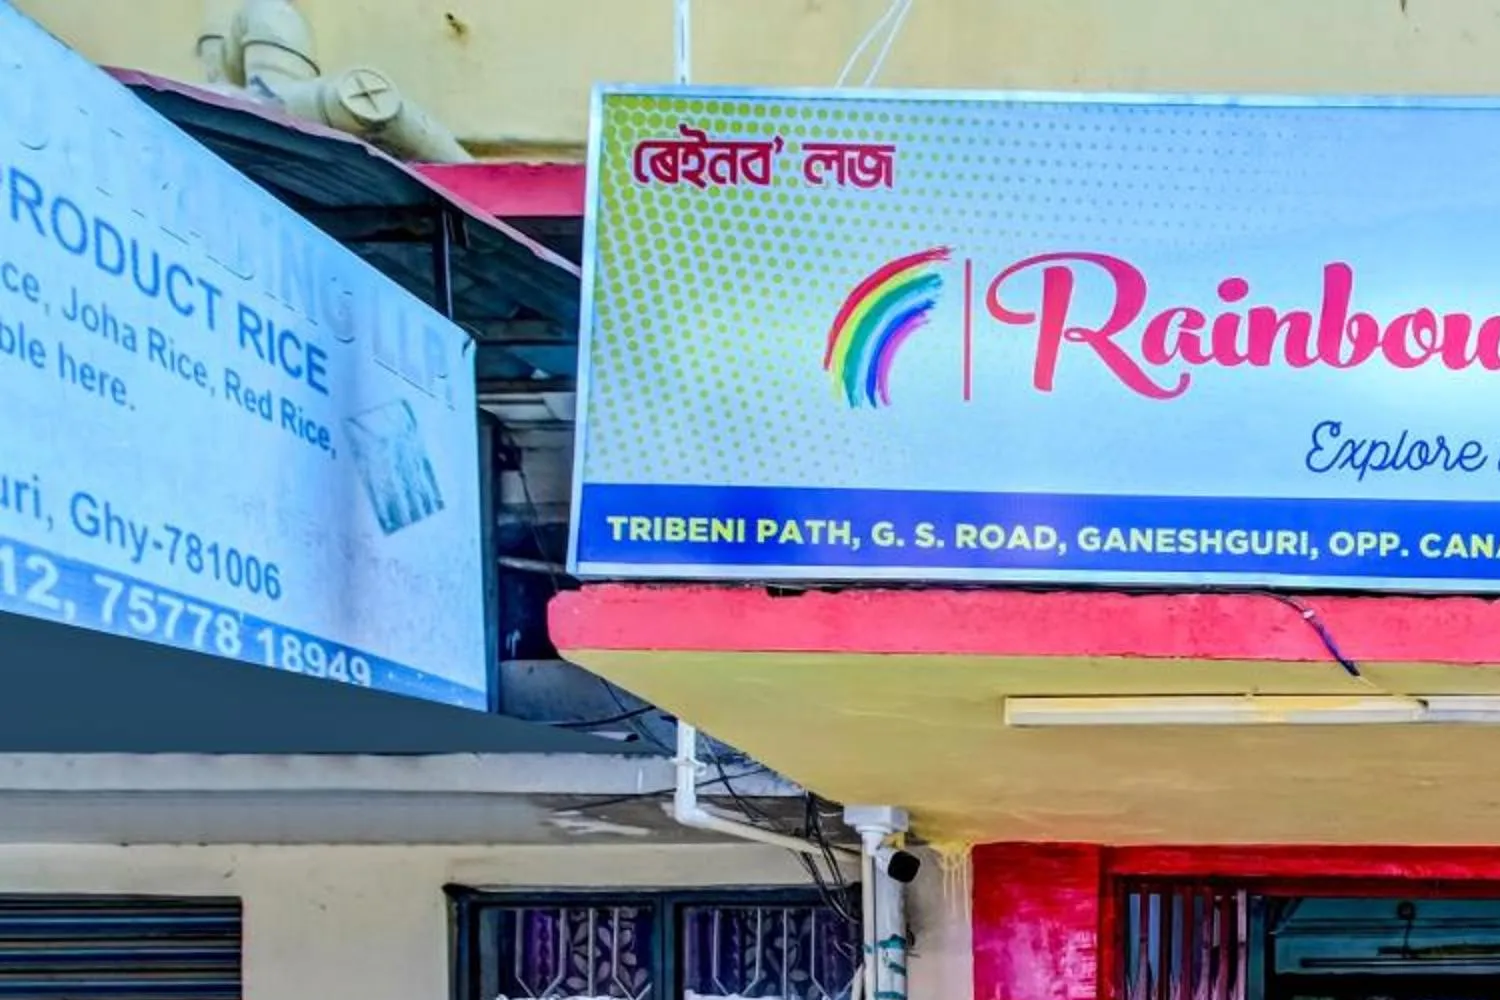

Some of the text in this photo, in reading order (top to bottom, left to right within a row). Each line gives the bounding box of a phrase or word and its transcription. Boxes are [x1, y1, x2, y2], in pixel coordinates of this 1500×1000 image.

[803, 144, 895, 188] লজ
[0, 165, 223, 331] RODUCT
[238, 301, 330, 397] RICE
[58, 341, 137, 412] here.
[61, 285, 138, 354] Joha
[148, 326, 216, 398] Rice,
[225, 367, 274, 423] Red
[280, 397, 337, 461] Rice,
[1304, 420, 1489, 482] Explore
[70, 491, 282, 601] Ghy-781006
[607, 515, 744, 543] TRIBENI
[756, 519, 860, 550] PATH,
[871, 523, 904, 548] G.
[915, 524, 944, 549] S.
[955, 524, 1067, 554] ROAD,
[1077, 526, 1319, 560] GANESHGURI,
[1329, 530, 1409, 558] OPP.
[93, 573, 244, 658] 75778
[256, 626, 373, 688] 18949
